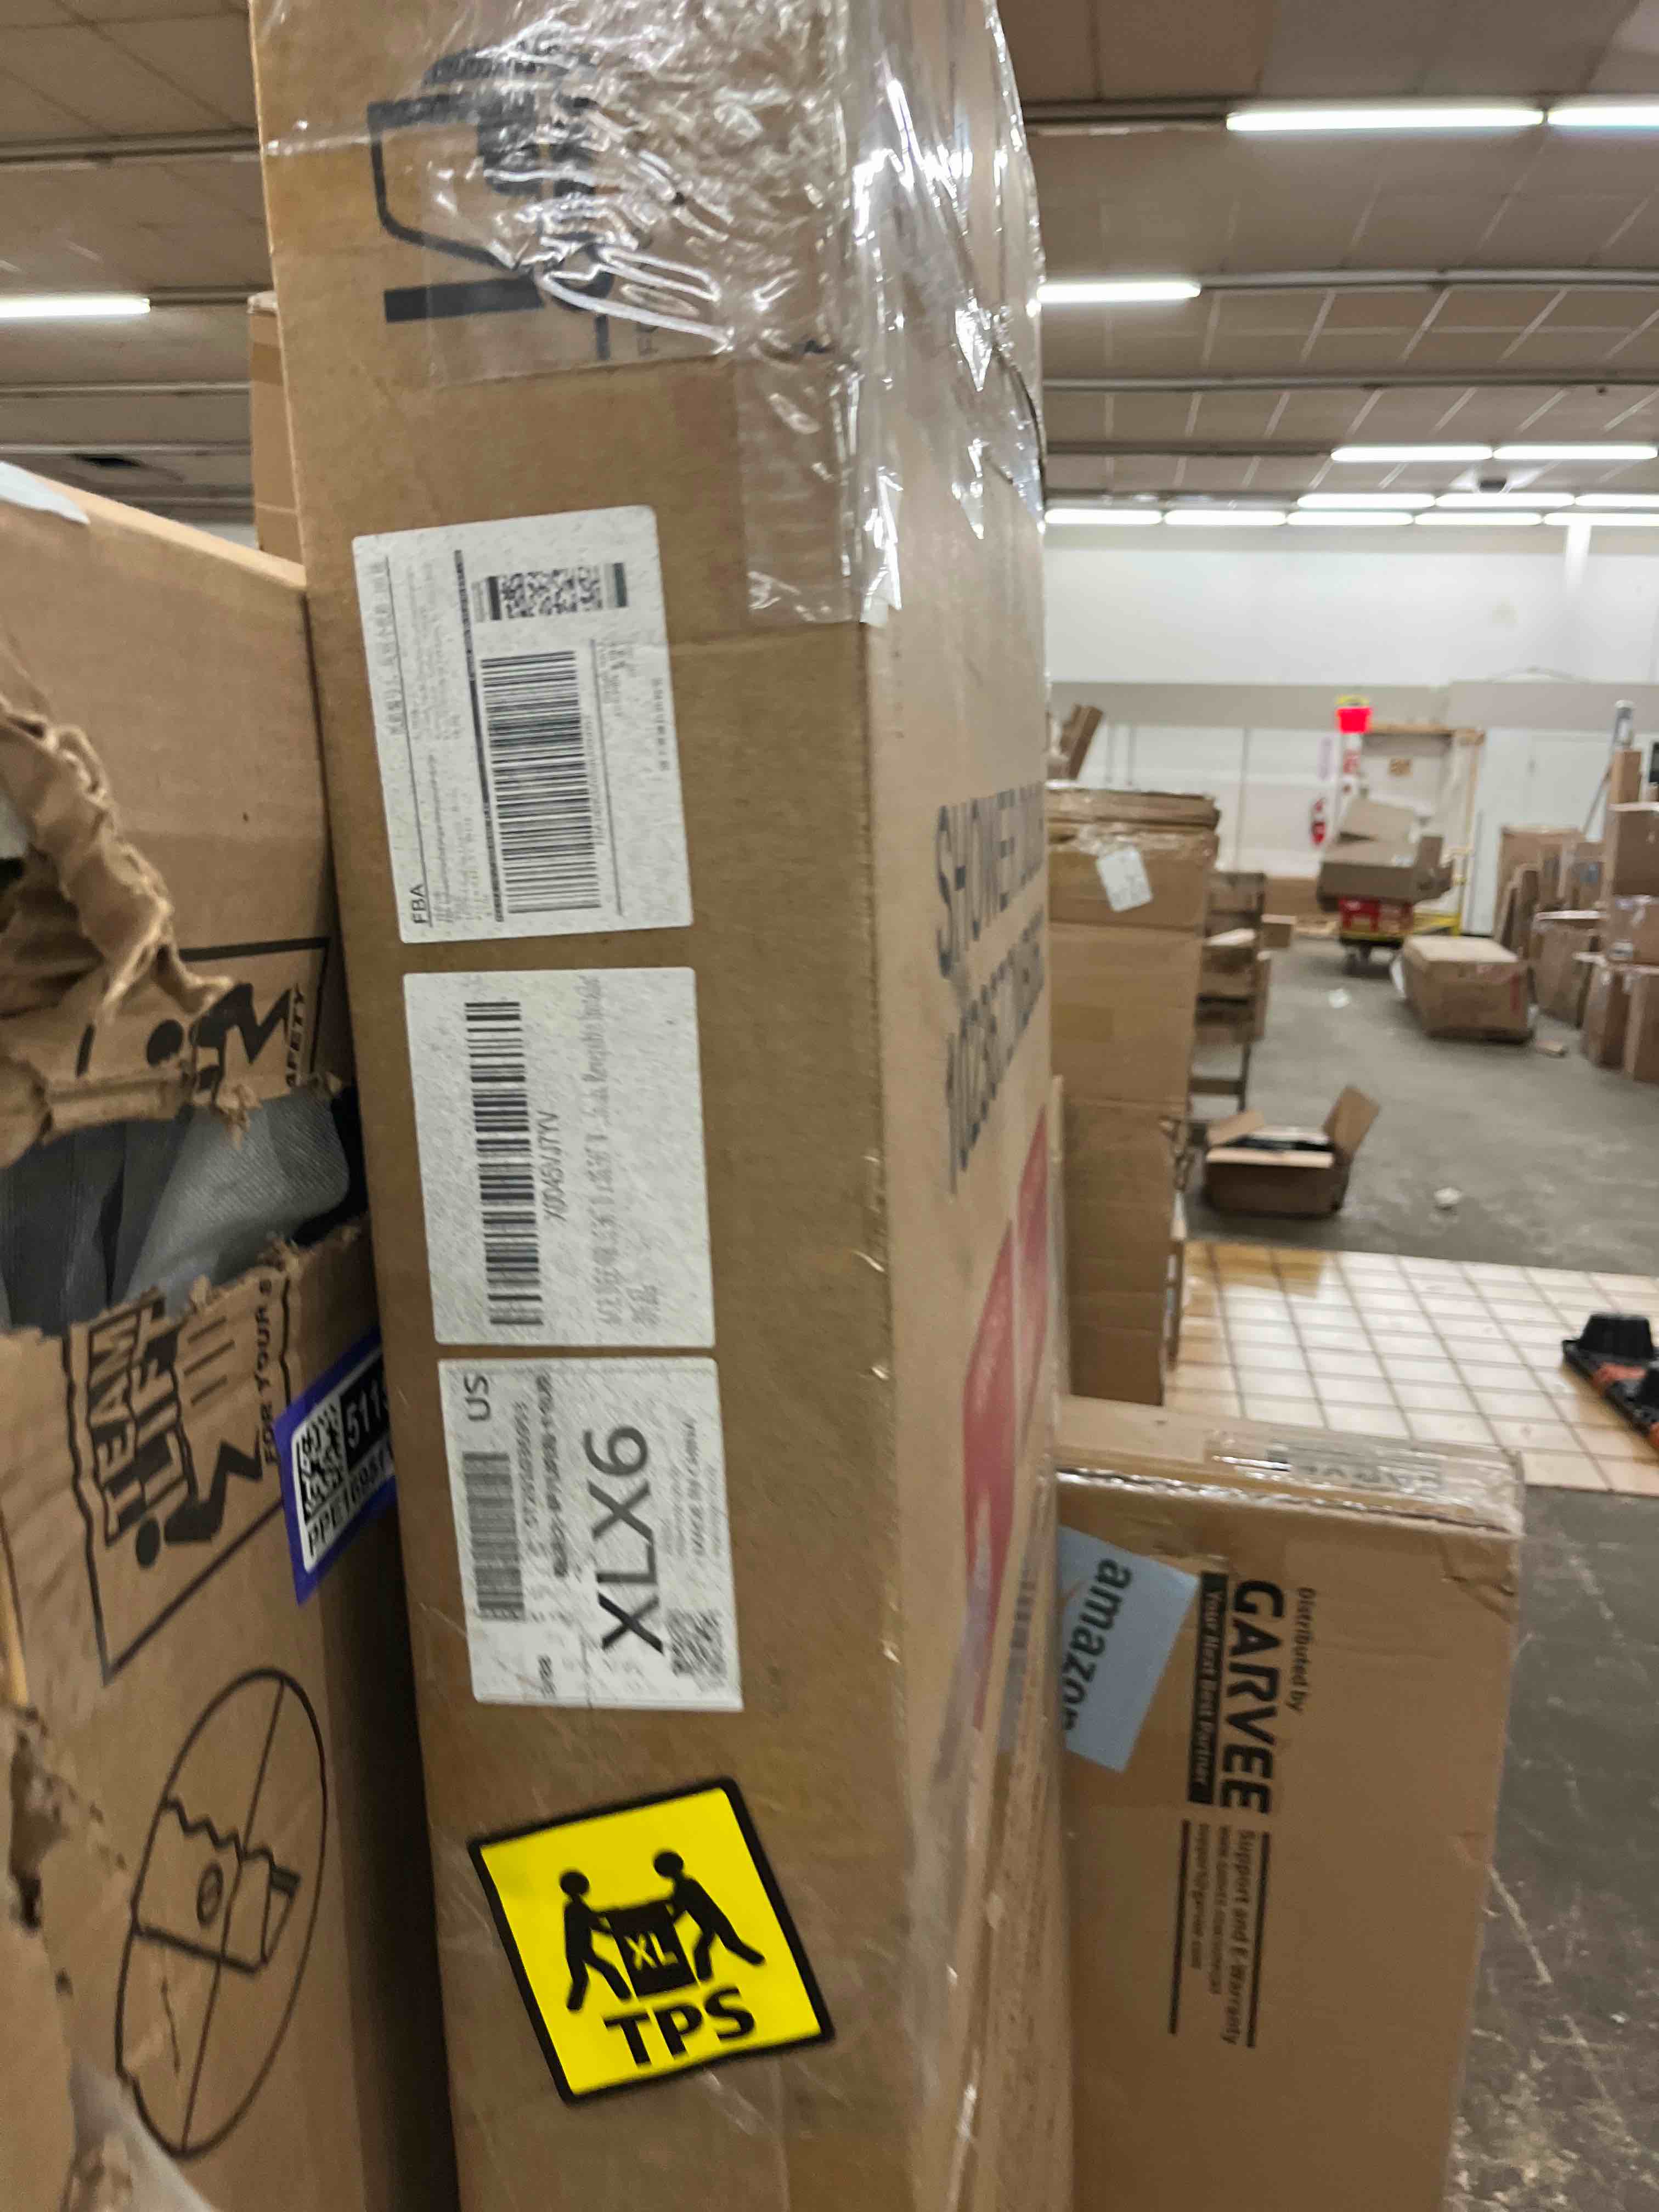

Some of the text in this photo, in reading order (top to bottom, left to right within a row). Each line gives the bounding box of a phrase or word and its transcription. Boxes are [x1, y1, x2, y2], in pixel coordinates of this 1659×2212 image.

[410, 882, 425, 924] FBA
[254, 1307, 270, 1393] YOUR
[89, 1312, 142, 1538] TEAM
[129, 1304, 185, 1509] LIFT
[464, 1373, 492, 1421] US
[583, 1425, 664, 1656] XLX6
[1286, 1587, 1316, 1713] Distributed by
[1220, 1579, 1284, 1815] GARVEE
[1234, 1830, 1256, 1903] Support
[627, 1931, 678, 1972] XL
[1232, 1908, 1250, 1942] and
[603, 1986, 755, 2068] TPS
